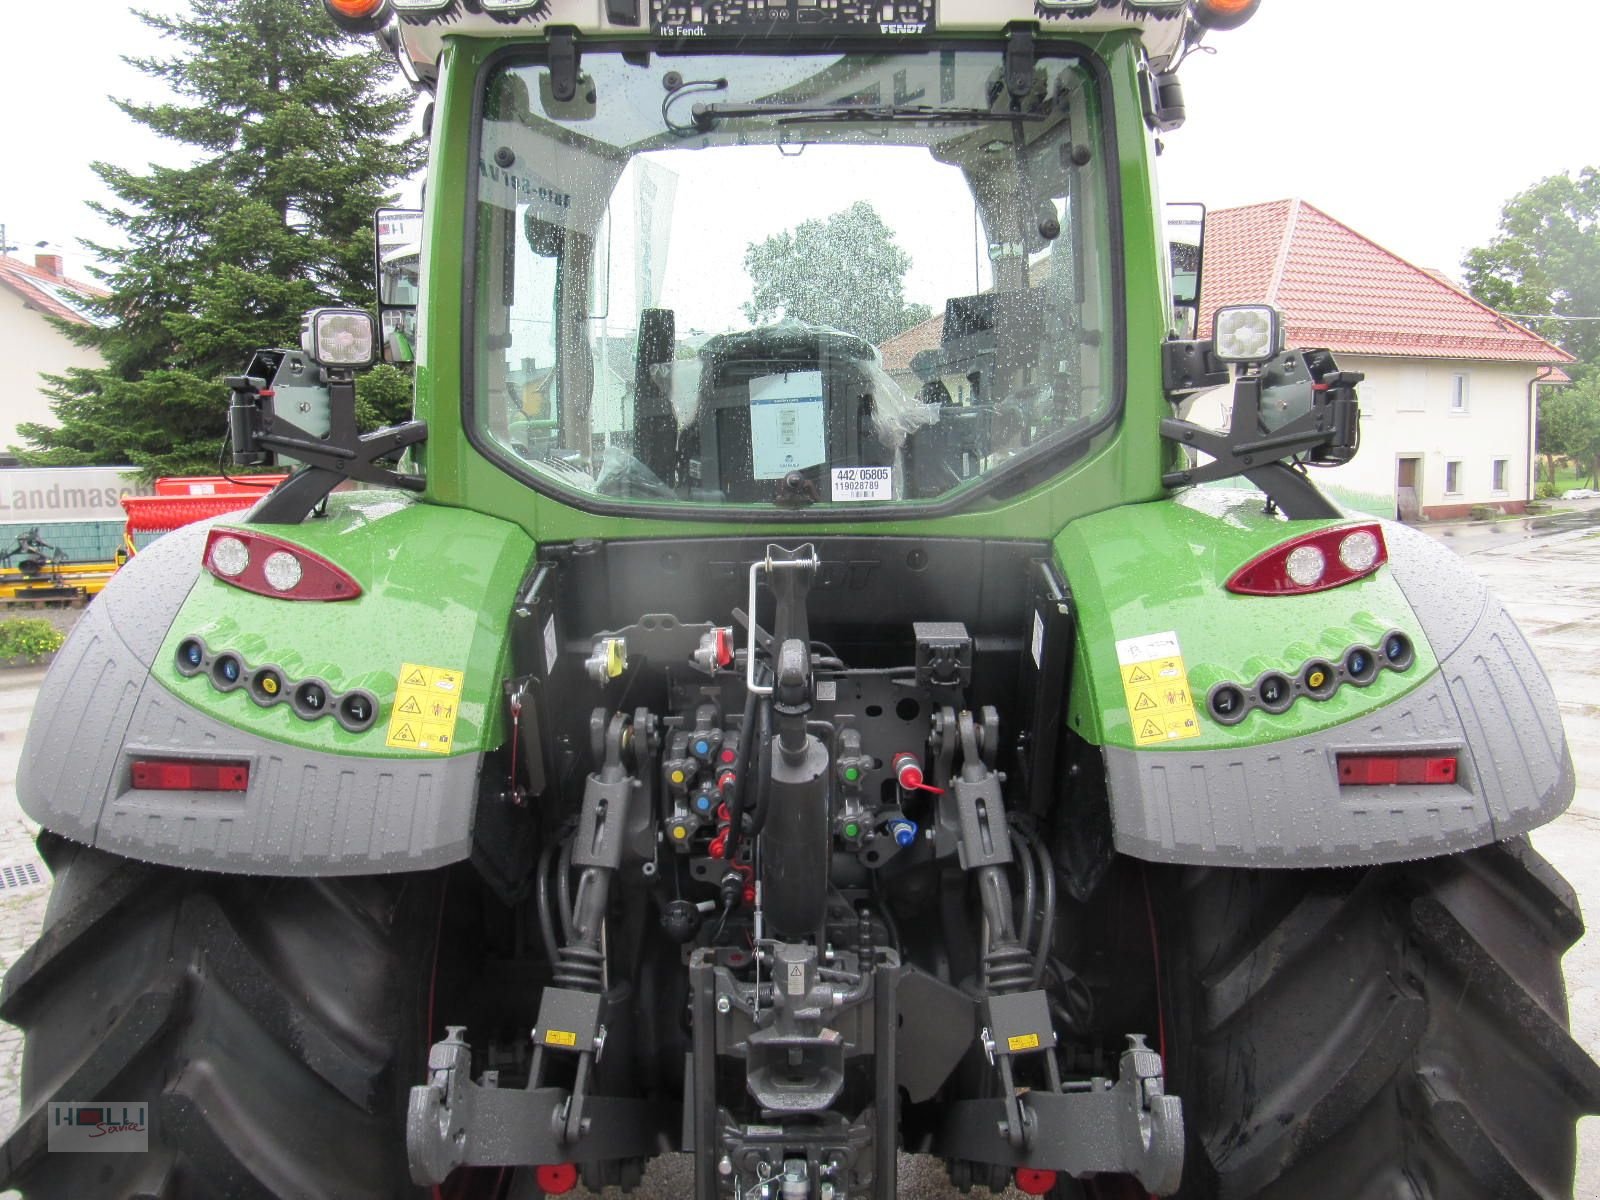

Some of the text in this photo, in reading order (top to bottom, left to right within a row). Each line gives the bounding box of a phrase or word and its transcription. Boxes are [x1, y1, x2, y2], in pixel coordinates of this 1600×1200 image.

[660, 26, 707, 36] It's Fendt.
[880, 24, 926, 34] FENDT
